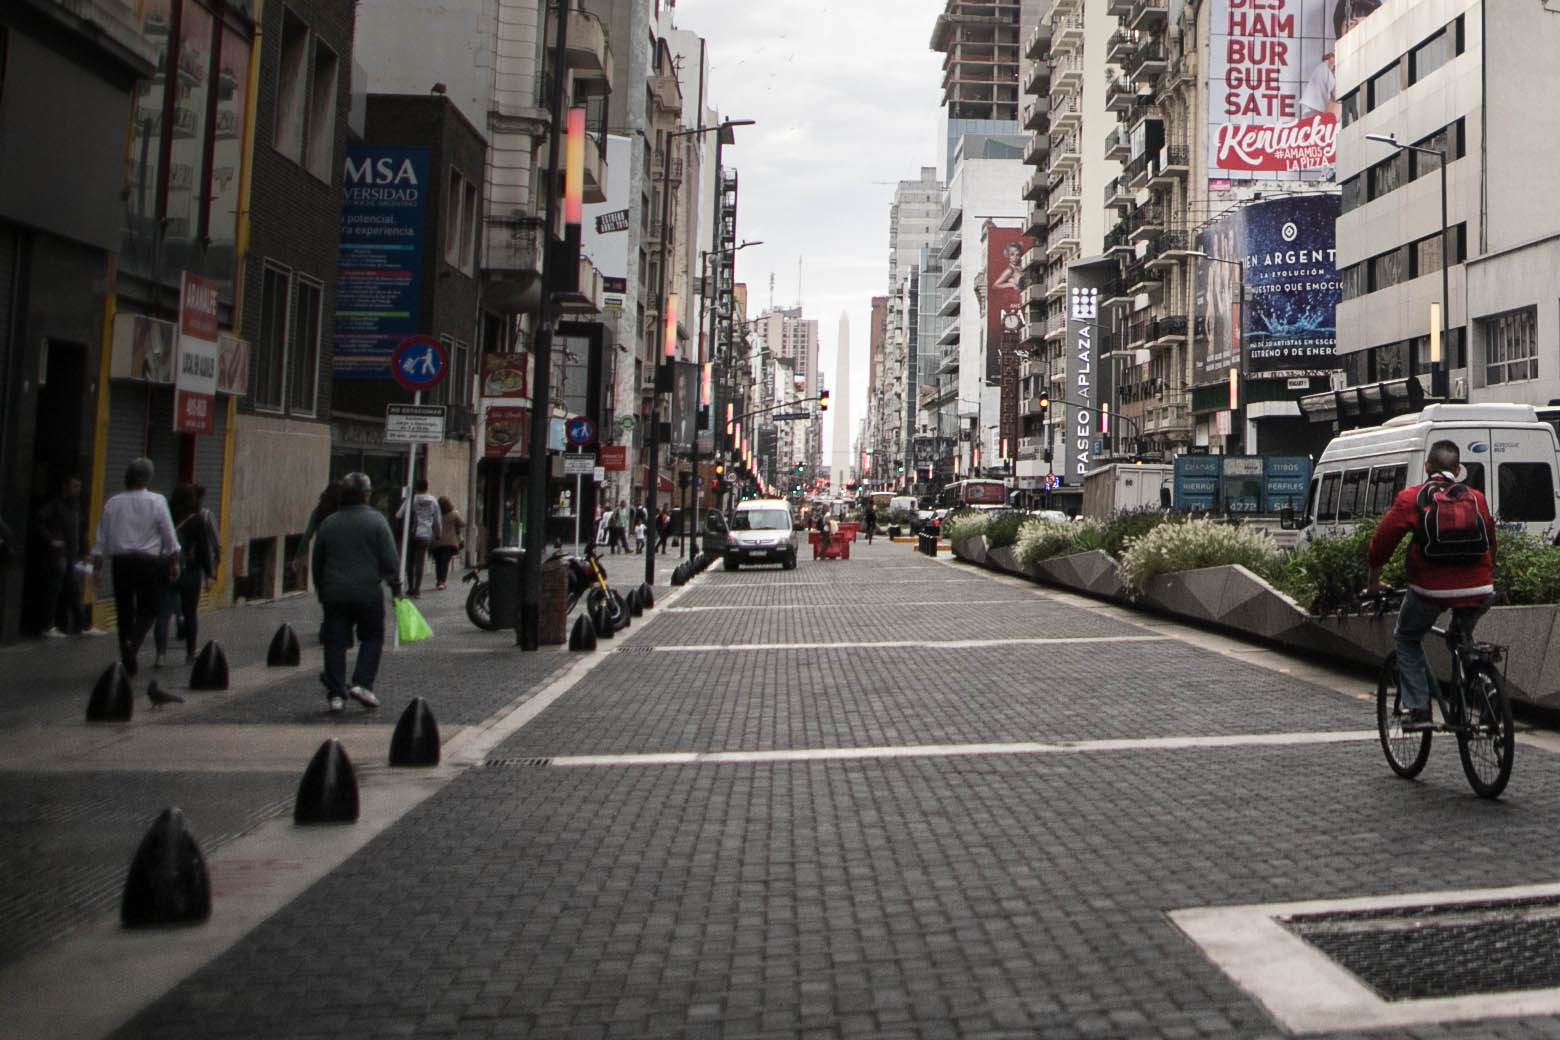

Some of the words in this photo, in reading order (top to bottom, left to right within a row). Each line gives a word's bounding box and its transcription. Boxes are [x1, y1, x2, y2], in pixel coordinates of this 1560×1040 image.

[1228, 12, 1295, 38] HAM
[1226, 39, 1288, 66] BUR
[1225, 68, 1281, 91] GUE
[1224, 92, 1296, 117] SATE
[1214, 115, 1340, 165] Kentucky
[1274, 147, 1323, 159] #AMAMOS
[344, 157, 418, 184] MSA
[1286, 159, 1300, 171] LA
[1301, 156, 1330, 170] PIZZA
[1264, 249, 1336, 266] ARGENT
[1272, 268, 1325, 278] EVOLUCIÓN
[1284, 282, 1303, 292] QUE
[1251, 348, 1281, 358] ESTRENO
[1283, 348, 1289, 356] 9
[1292, 347, 1303, 356] DE
